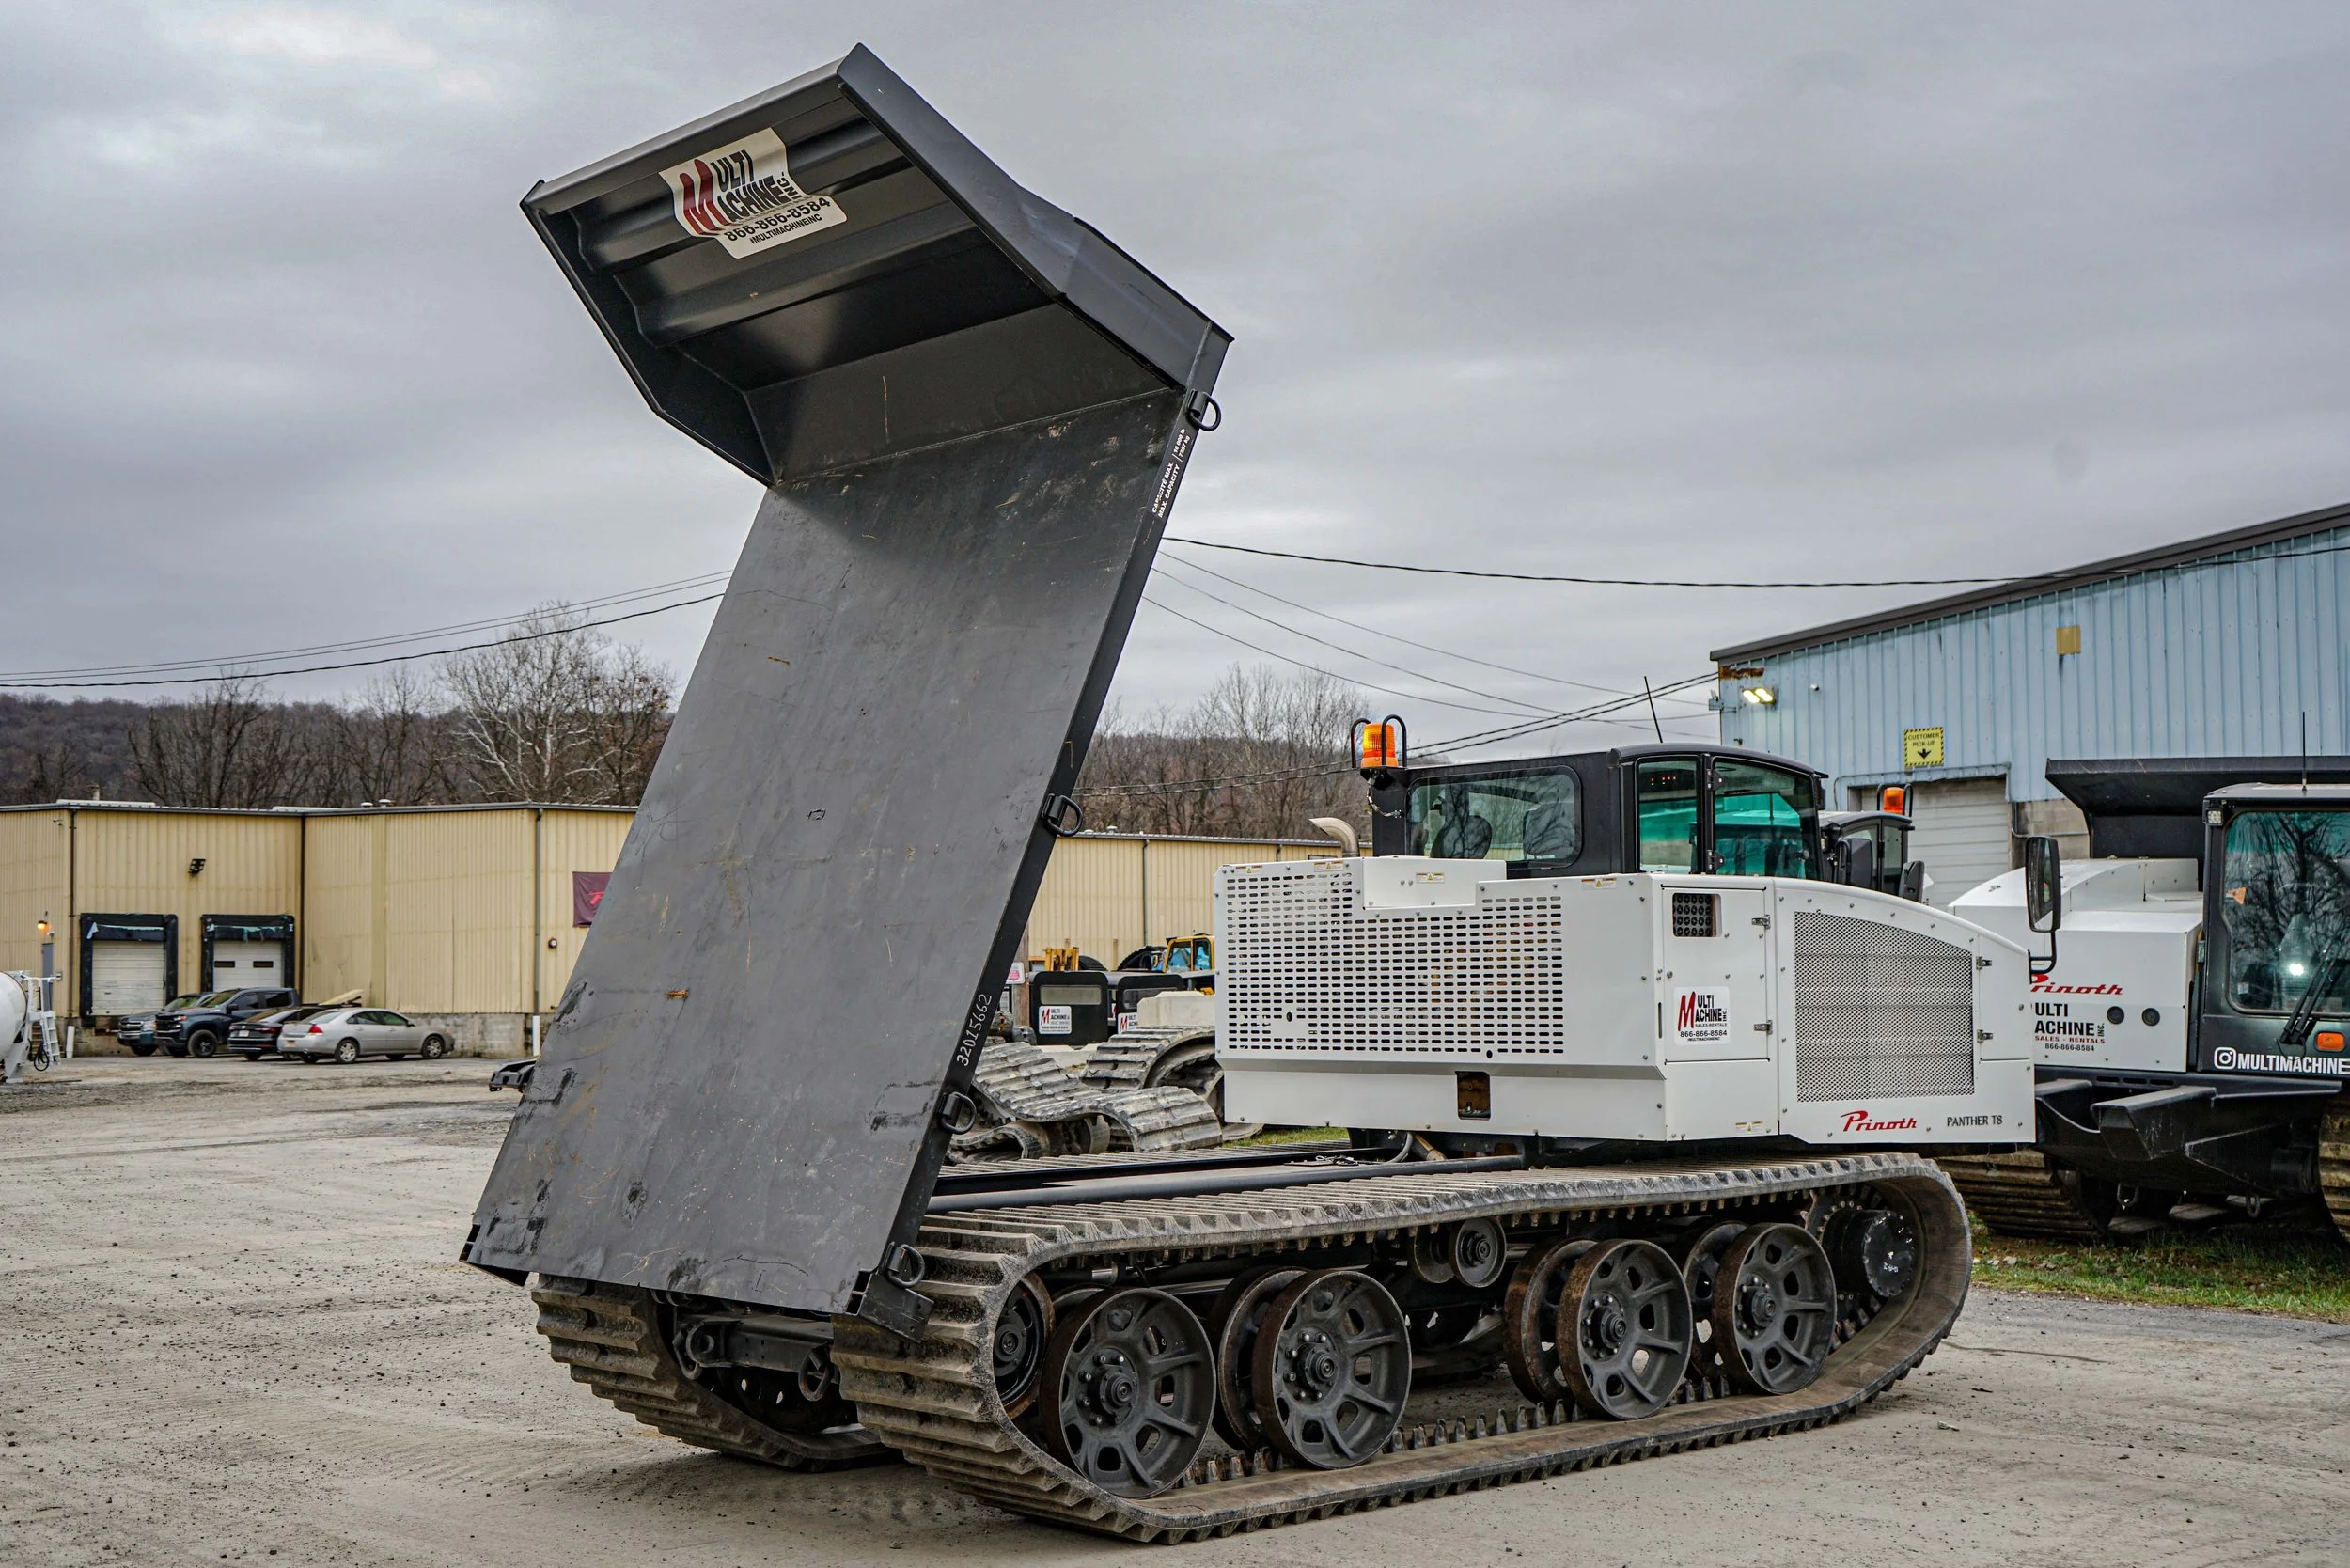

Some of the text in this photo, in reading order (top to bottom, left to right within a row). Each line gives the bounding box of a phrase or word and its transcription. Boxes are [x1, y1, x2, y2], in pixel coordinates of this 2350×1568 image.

[725, 197, 831, 242] 866-866-8584
[1165, 463, 1181, 499] CAPACITY
[2035, 1002, 2069, 1017] ULTI
[957, 994, 993, 1067] 32015662
[2034, 1020, 2106, 1037] ACHINE INC.
[2044, 1043, 2095, 1052] 866-866-8584
[1840, 1110, 1918, 1132] Prinoth
[1947, 1115, 2003, 1127] PANTHER T8
